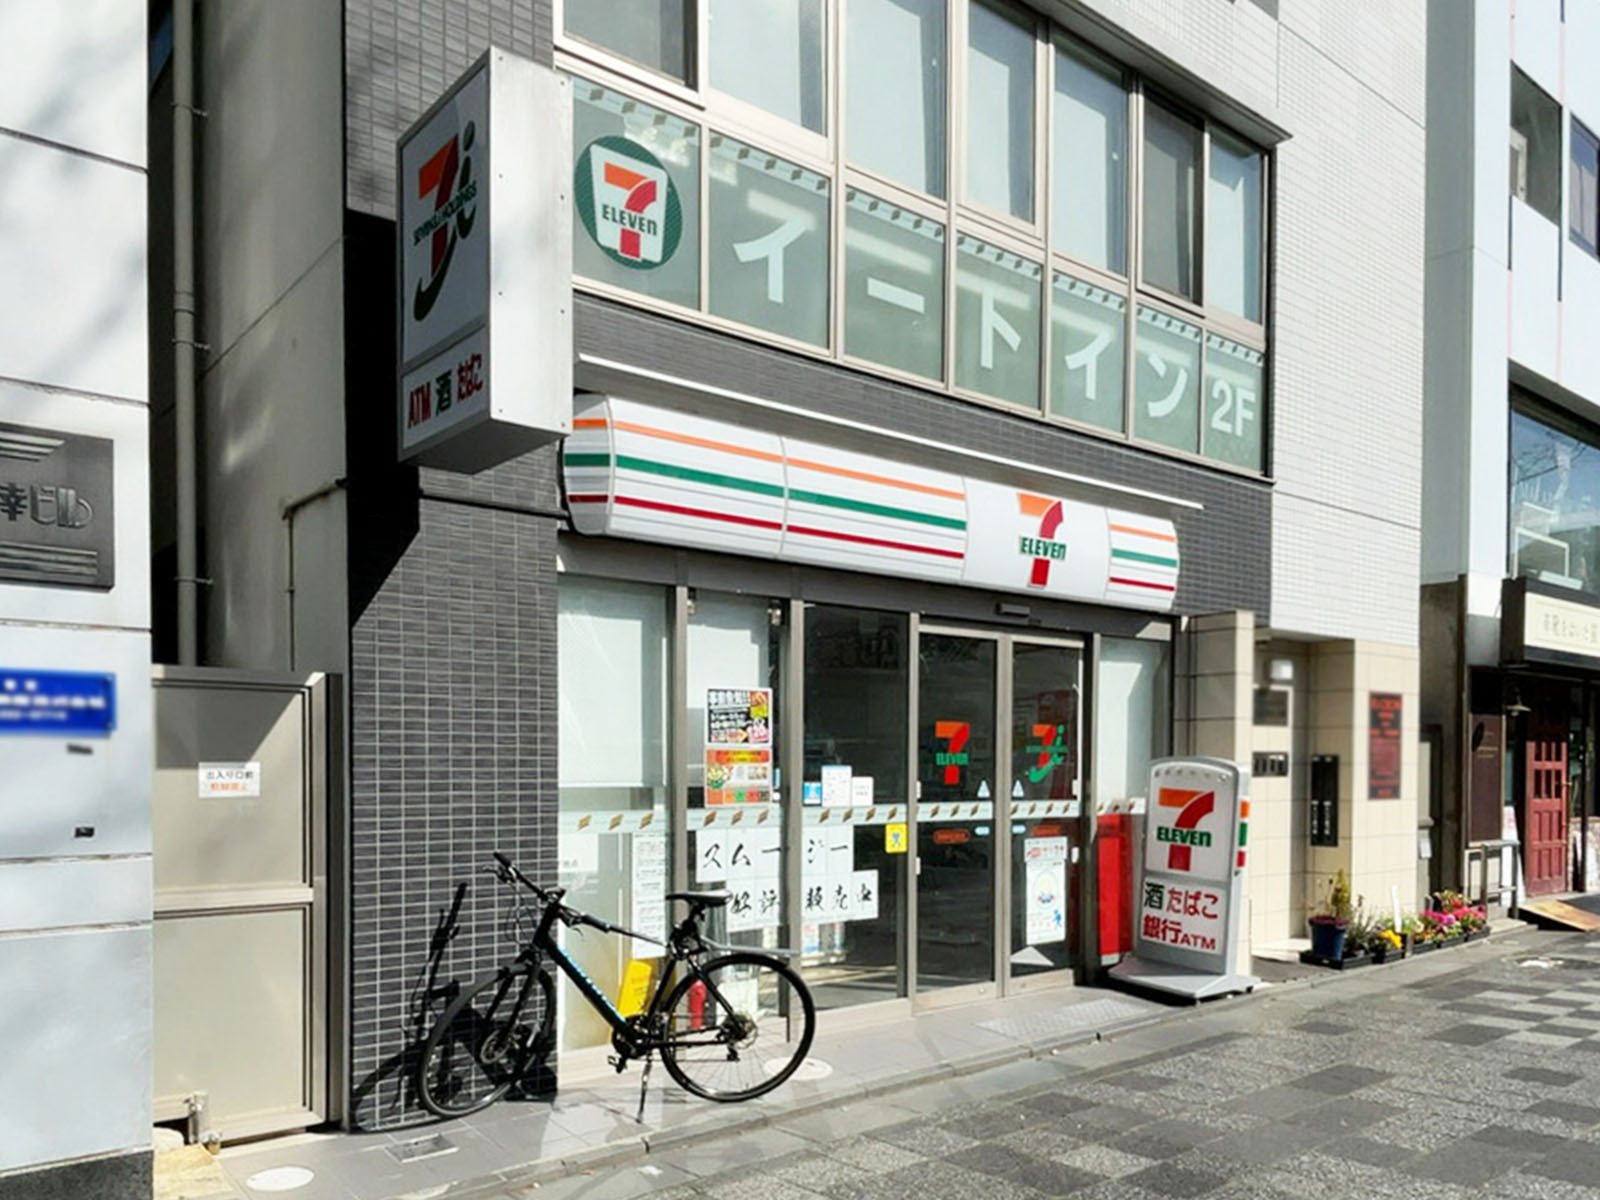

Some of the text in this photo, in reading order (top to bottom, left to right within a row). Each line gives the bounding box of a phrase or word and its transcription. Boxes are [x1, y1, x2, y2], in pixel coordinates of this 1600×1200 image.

[733, 220, 1255, 436] イートイン 2F
[408, 381, 431, 429] ATM
[436, 369, 452, 416] 酒
[1144, 882, 1218, 919] 酒 たばこ
